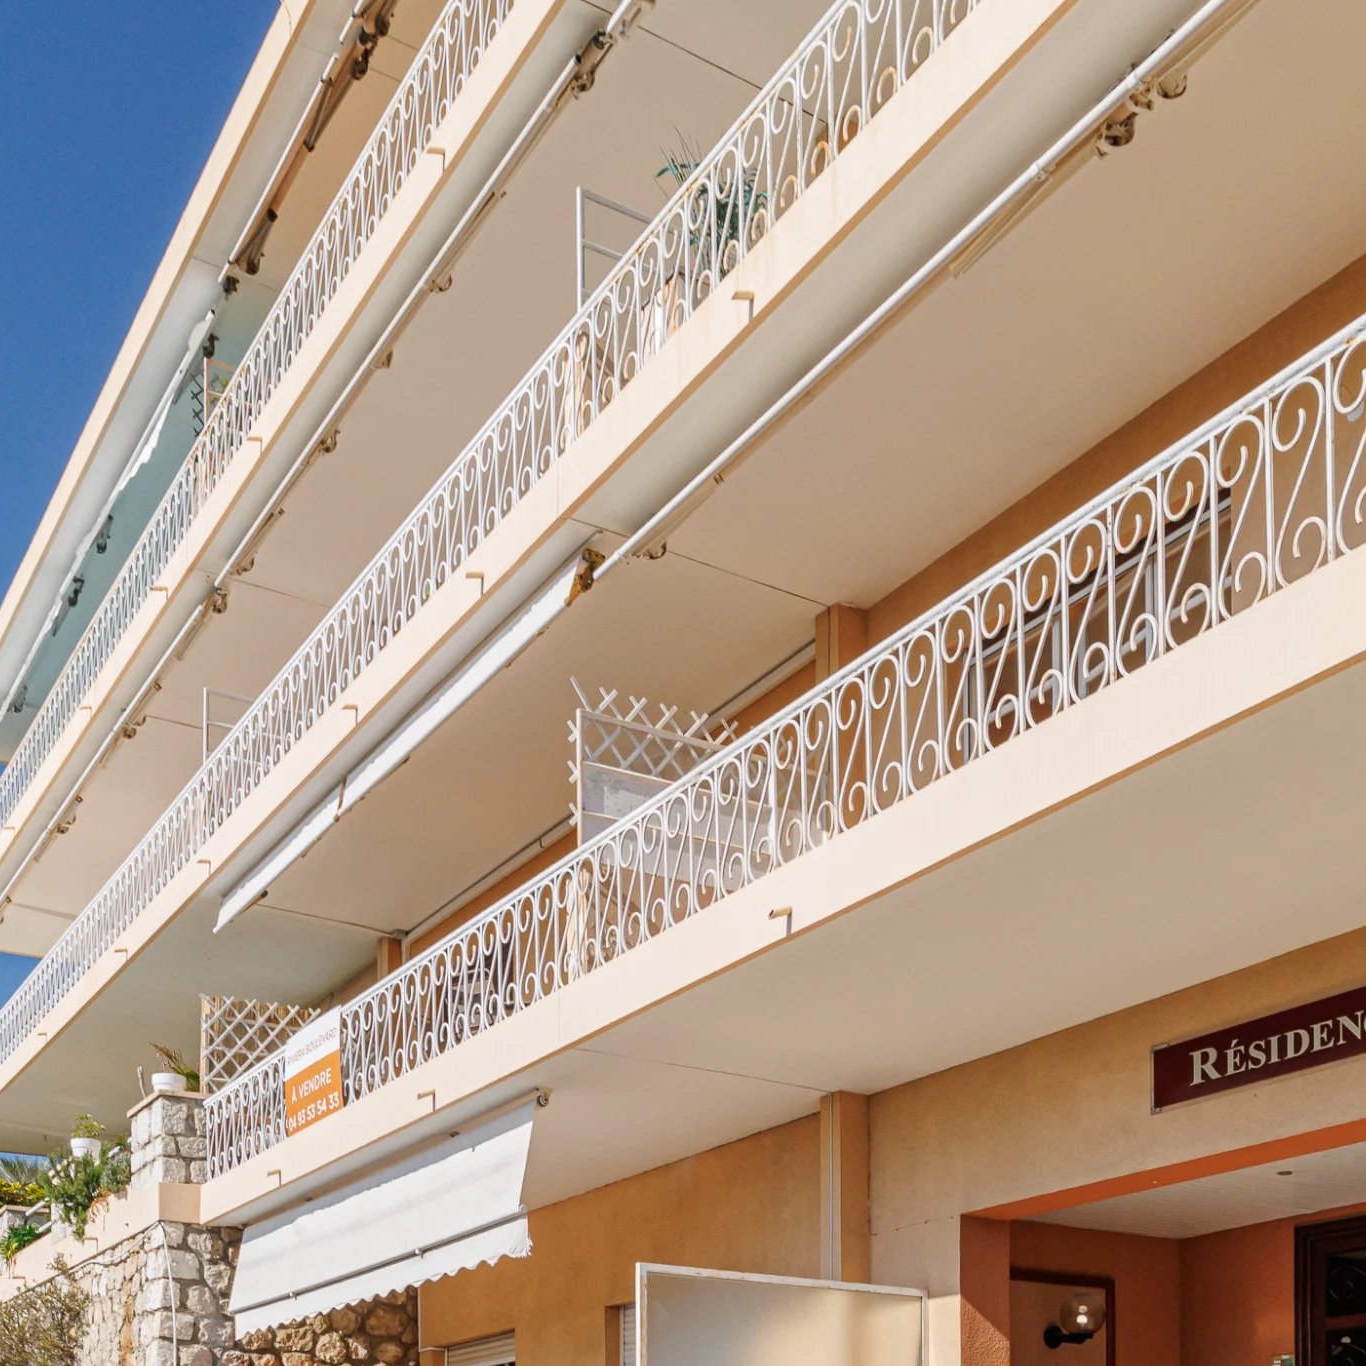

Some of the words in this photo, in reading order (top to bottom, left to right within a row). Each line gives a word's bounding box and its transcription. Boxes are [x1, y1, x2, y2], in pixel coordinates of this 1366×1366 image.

[298, 1067, 332, 1099] VENDRE
[297, 1109, 305, 1126] 93
[306, 1103, 315, 1120] 53
[316, 1097, 327, 1115] 54
[329, 1091, 339, 1110] 33
